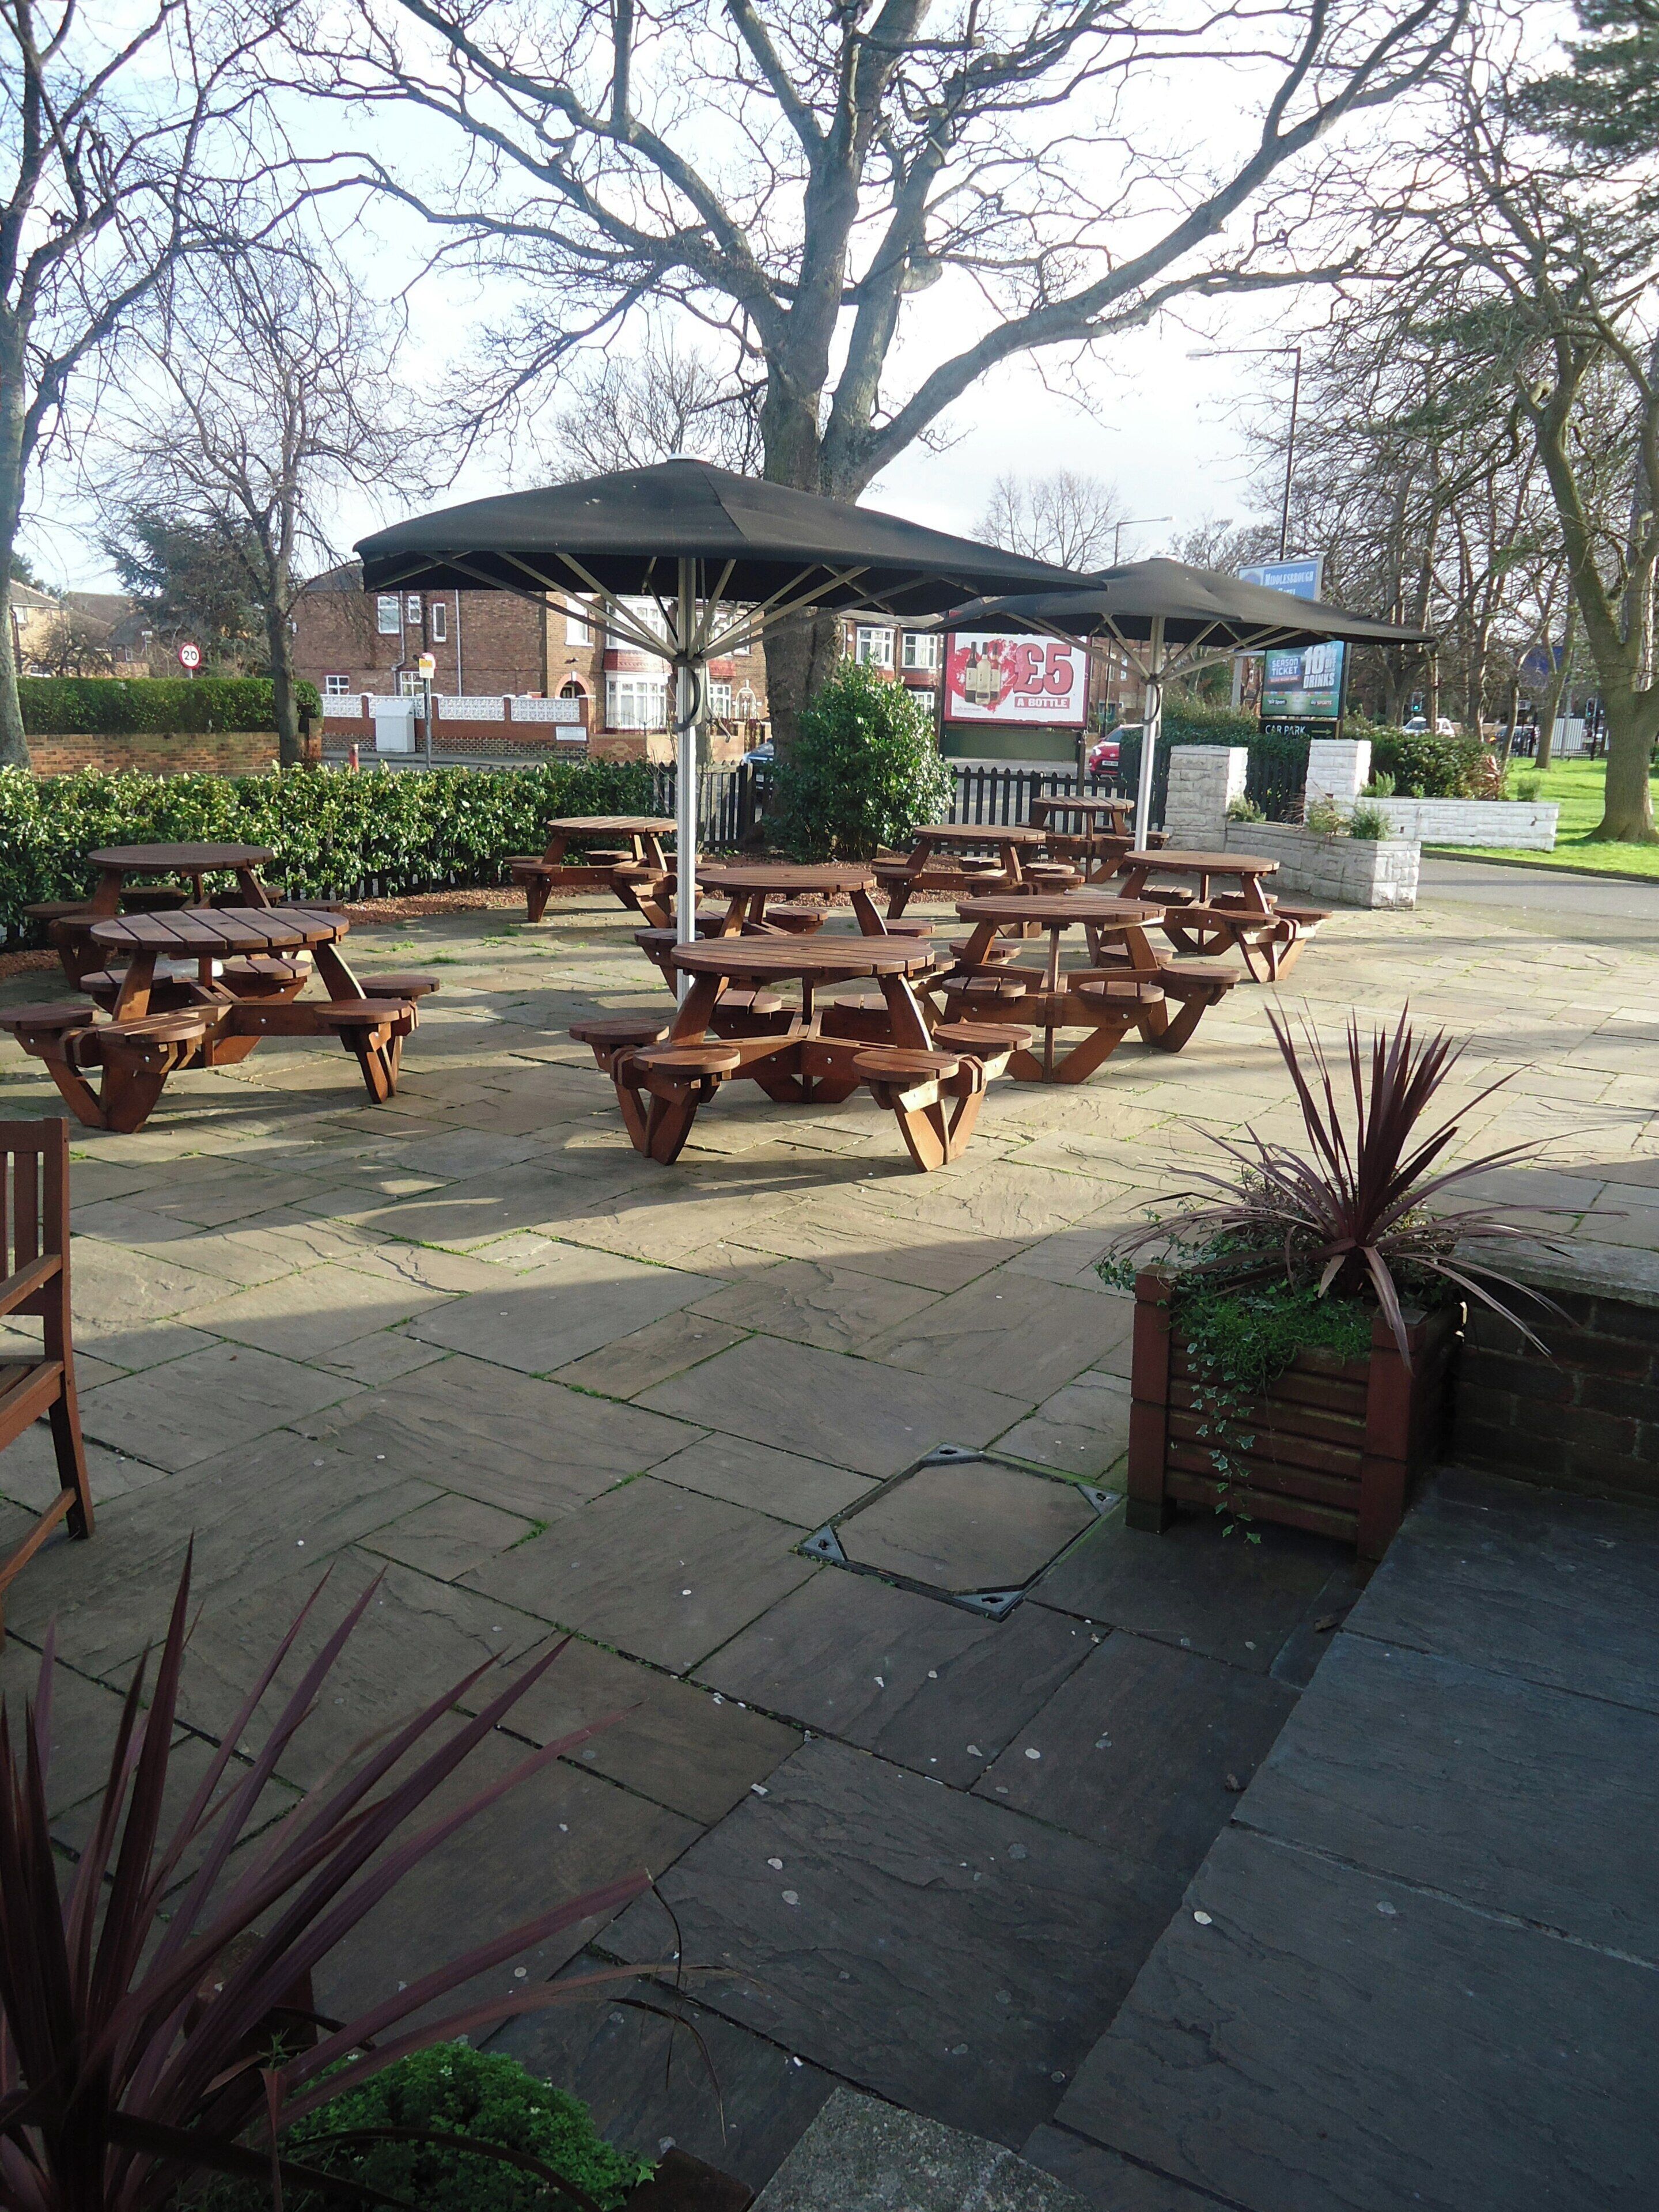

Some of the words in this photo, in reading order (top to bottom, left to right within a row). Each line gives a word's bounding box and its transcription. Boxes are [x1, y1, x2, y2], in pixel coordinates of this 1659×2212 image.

[1264, 571, 1314, 586] MIDDLESBROUGH
[183, 650, 198, 661] 20
[1271, 658, 1299, 668] SEASON
[1013, 643, 1074, 695] £5
[1271, 666, 1298, 676] TICKET
[1302, 672, 1335, 689] DRINKS
[1017, 698, 1025, 707] A
[1028, 698, 1067, 707] BOTTLE
[1265, 725, 1282, 734] CAR
[1283, 725, 1306, 736] PARK
